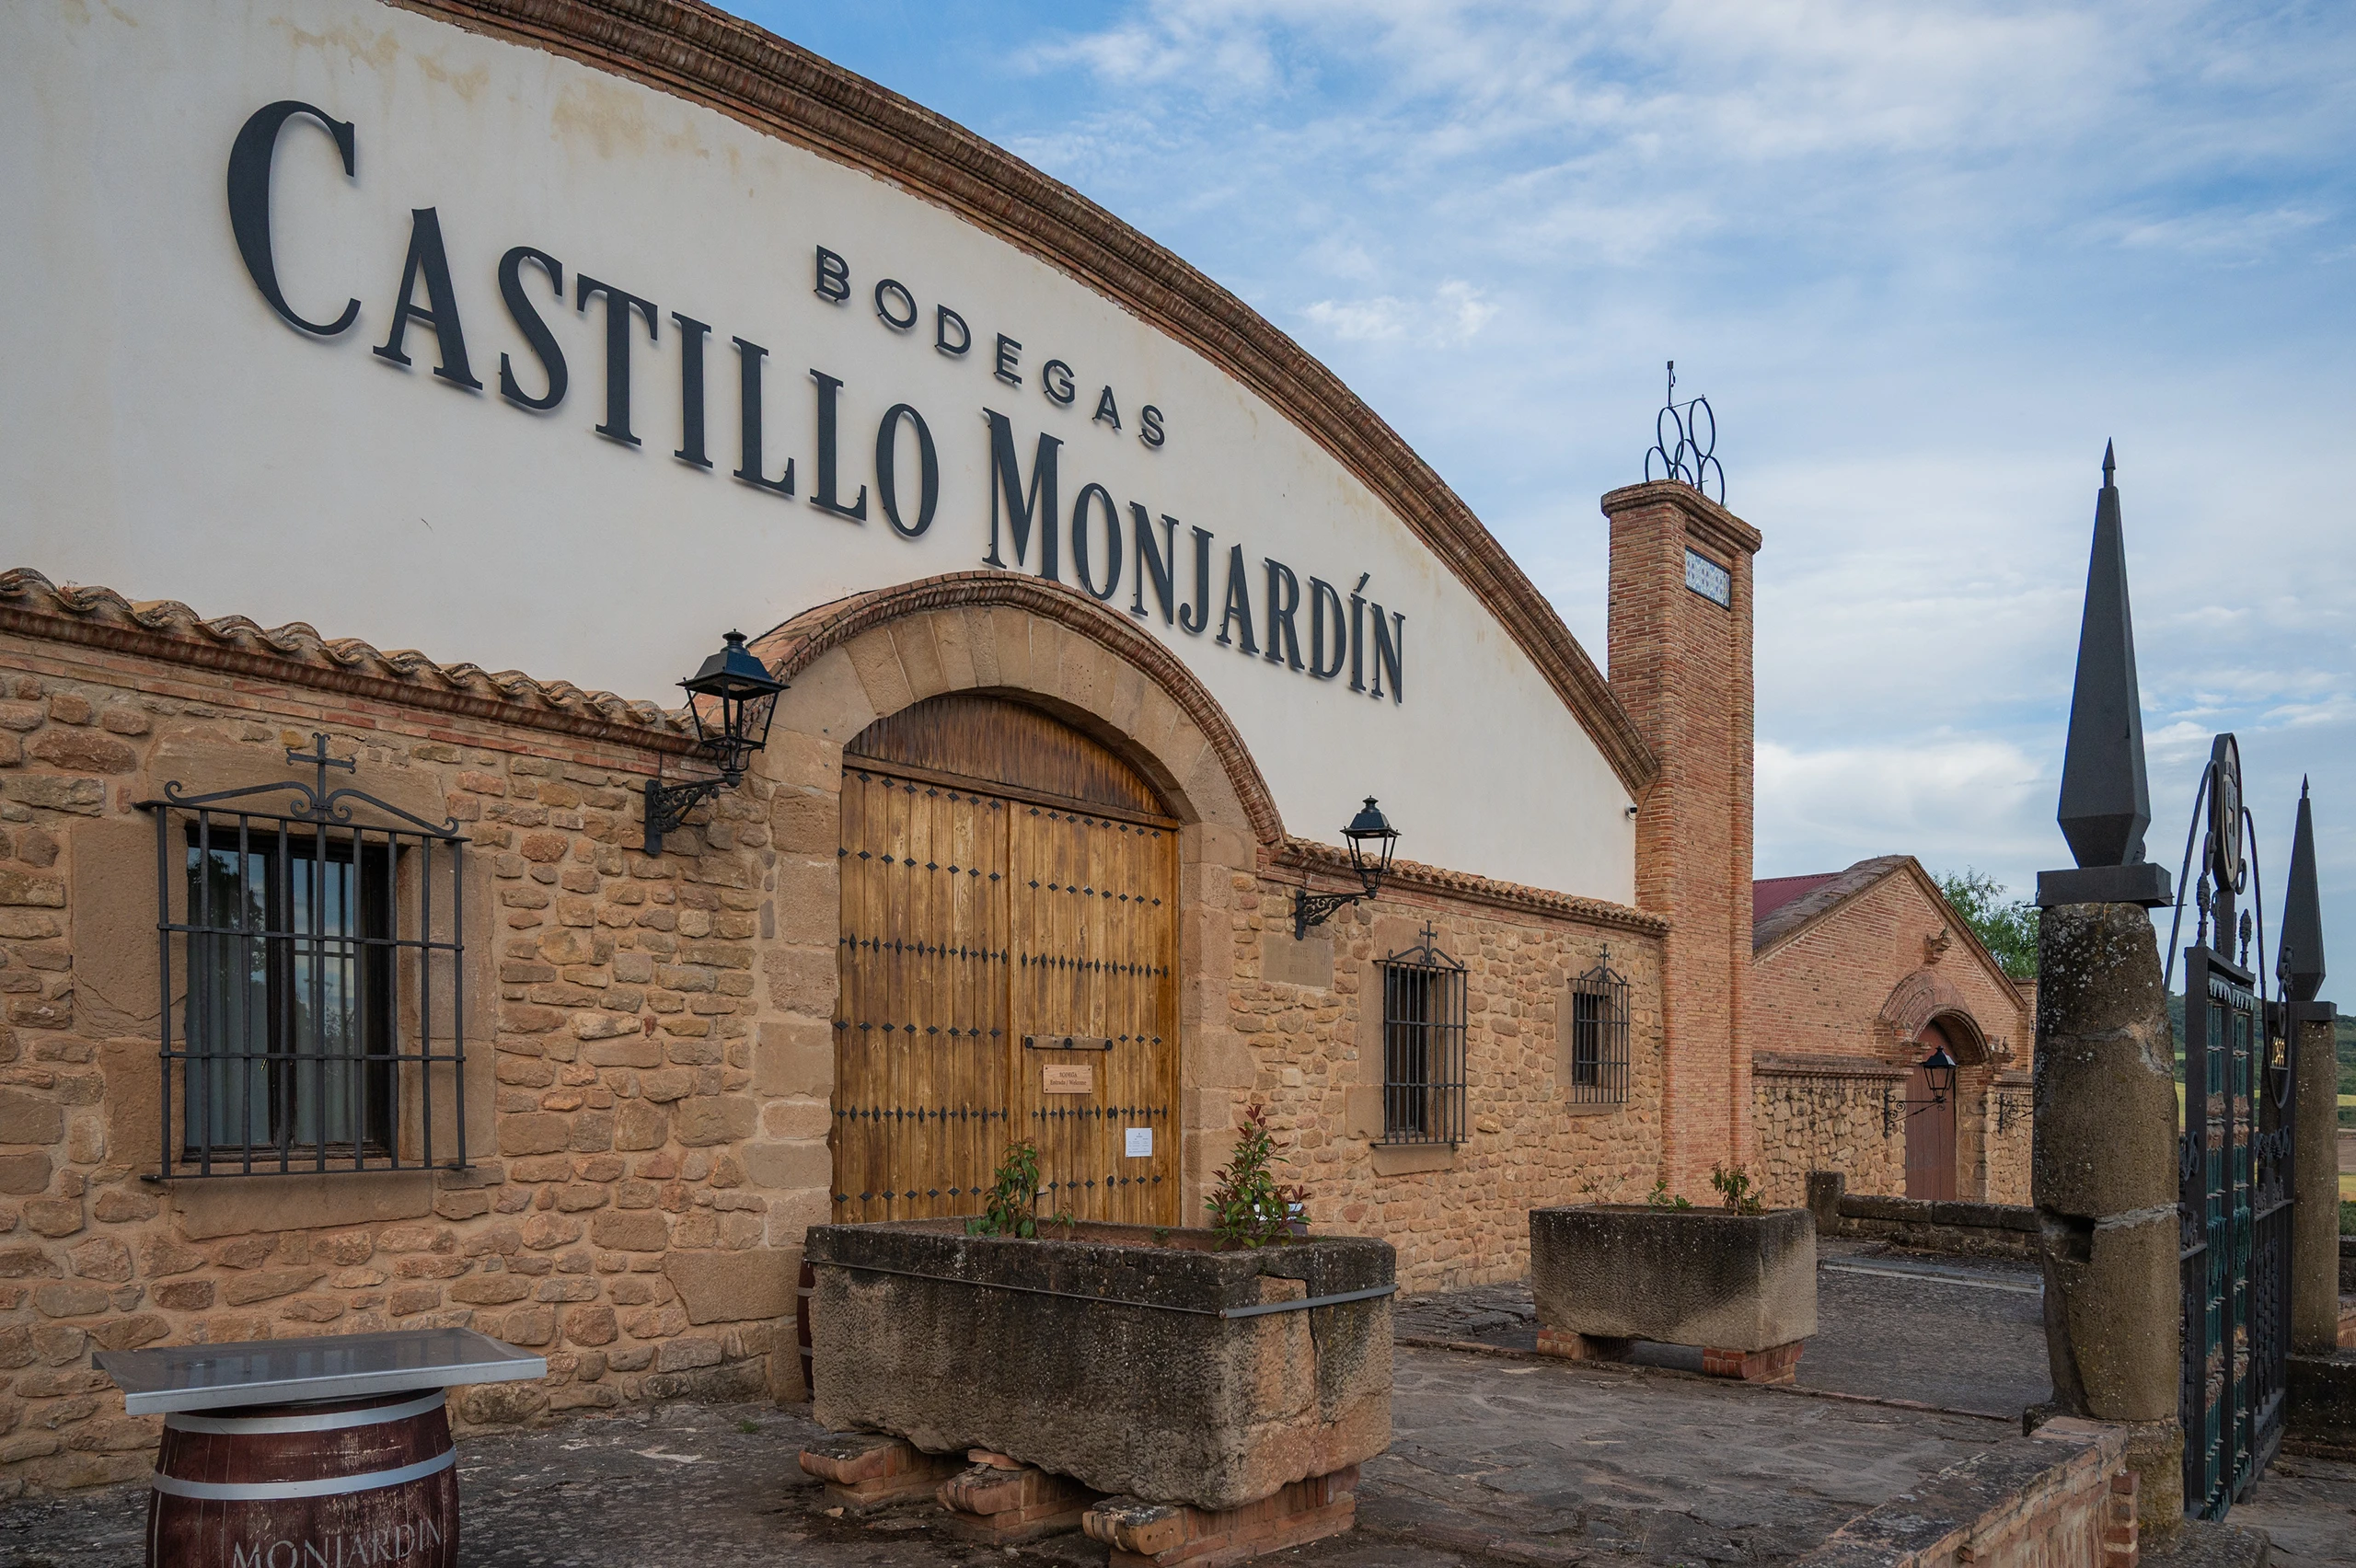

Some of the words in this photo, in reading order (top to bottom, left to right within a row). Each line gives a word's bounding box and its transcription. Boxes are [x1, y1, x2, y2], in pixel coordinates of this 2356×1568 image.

[227, 99, 940, 538] CASTILLO
[981, 406, 1406, 704] MONJARDÍN
[814, 245, 1166, 446] BODEGAS
